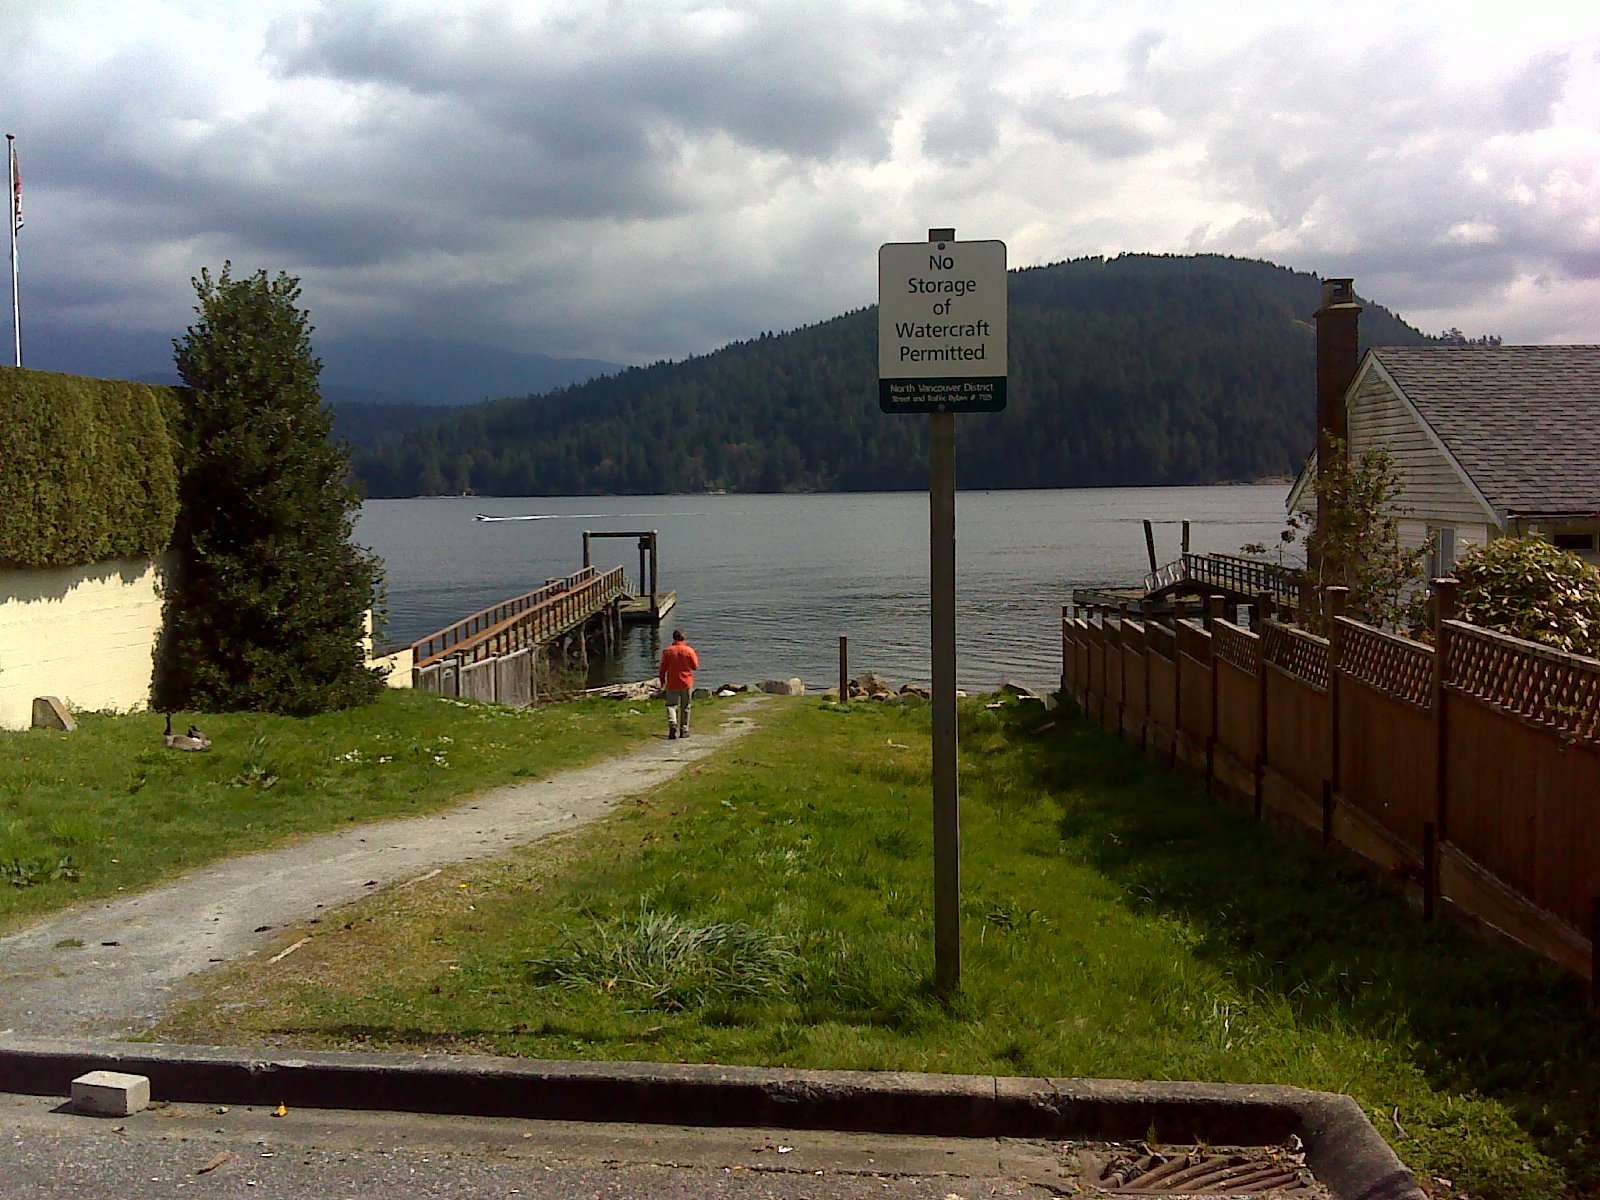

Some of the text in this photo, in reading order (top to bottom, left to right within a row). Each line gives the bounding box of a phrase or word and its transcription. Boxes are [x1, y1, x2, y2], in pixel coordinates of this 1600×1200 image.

[930, 255, 954, 270] No
[908, 278, 976, 296] Storage
[933, 299, 951, 315] of
[896, 320, 989, 338] Watercraft
[901, 344, 984, 361] Permitted
[890, 383, 993, 394] North Vancouver District
[892, 395, 910, 403] Street
